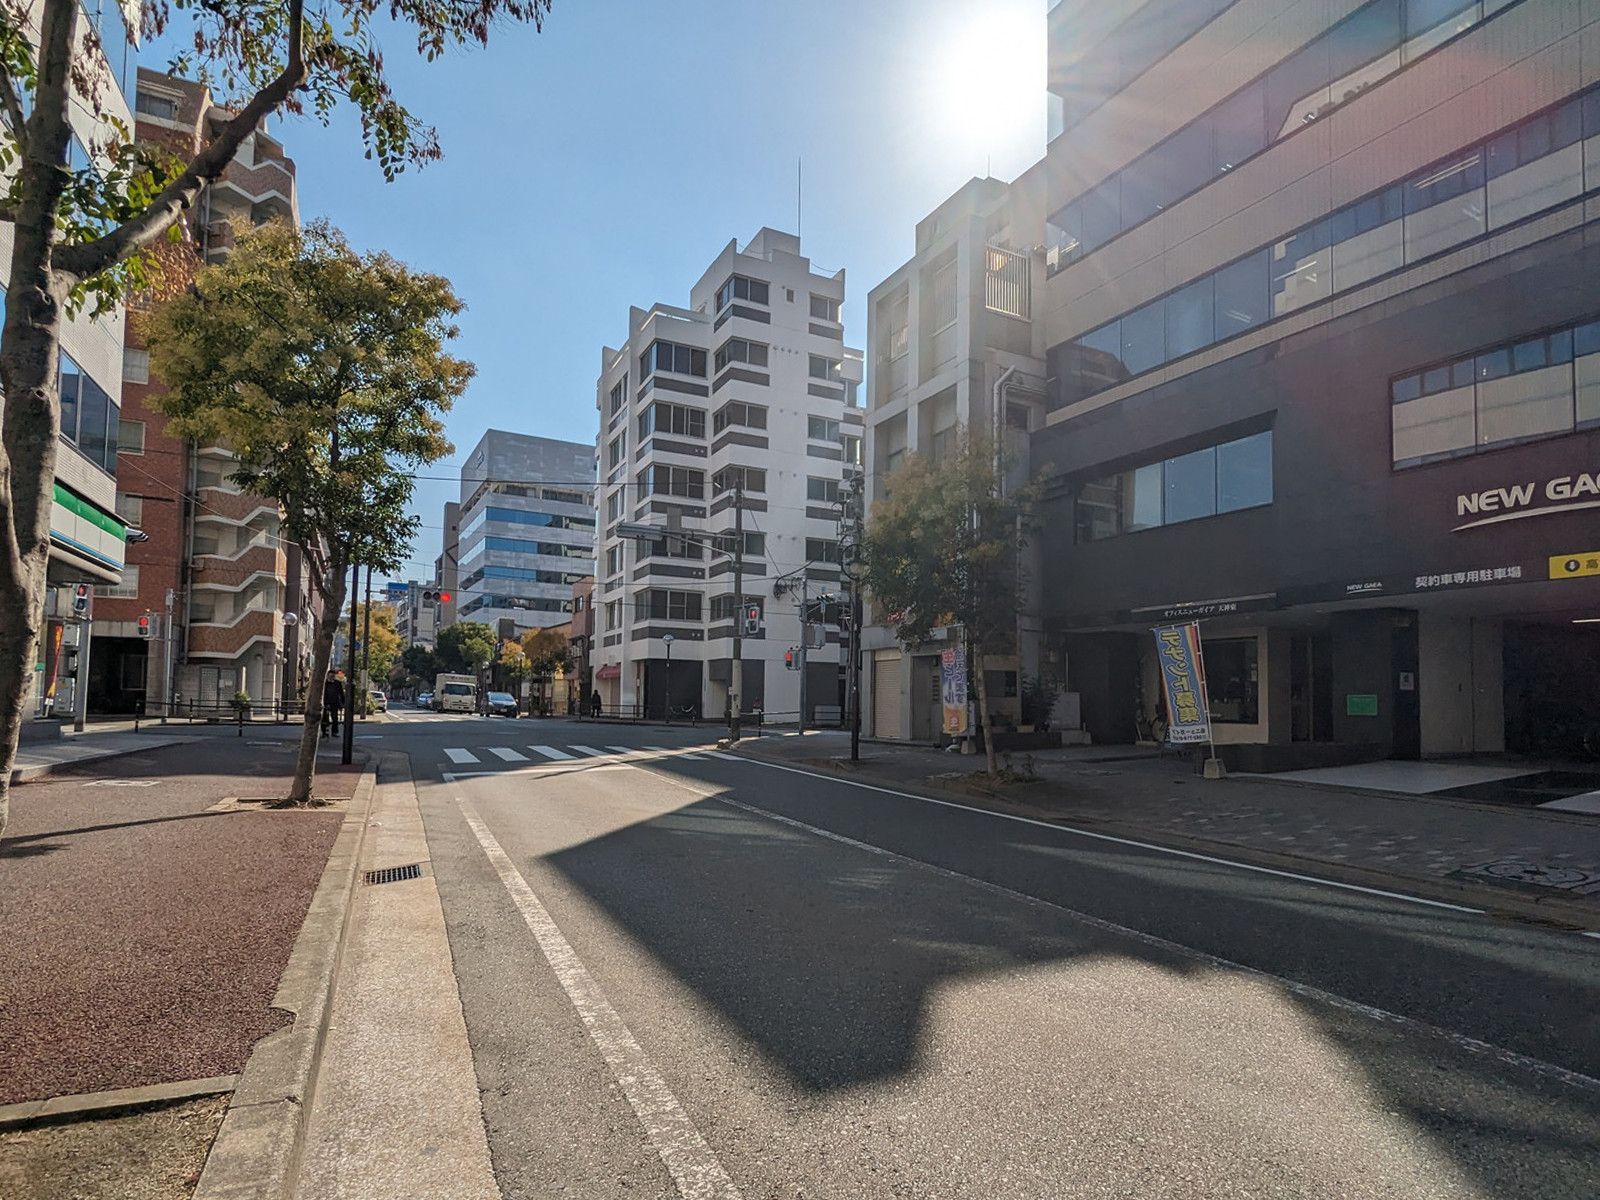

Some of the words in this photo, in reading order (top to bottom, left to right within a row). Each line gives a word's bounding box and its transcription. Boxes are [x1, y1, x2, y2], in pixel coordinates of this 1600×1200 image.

[1456, 482, 1536, 516] NEW
[1545, 472, 1600, 501] GA
[1415, 565, 1522, 589] 契約車専用駐車場
